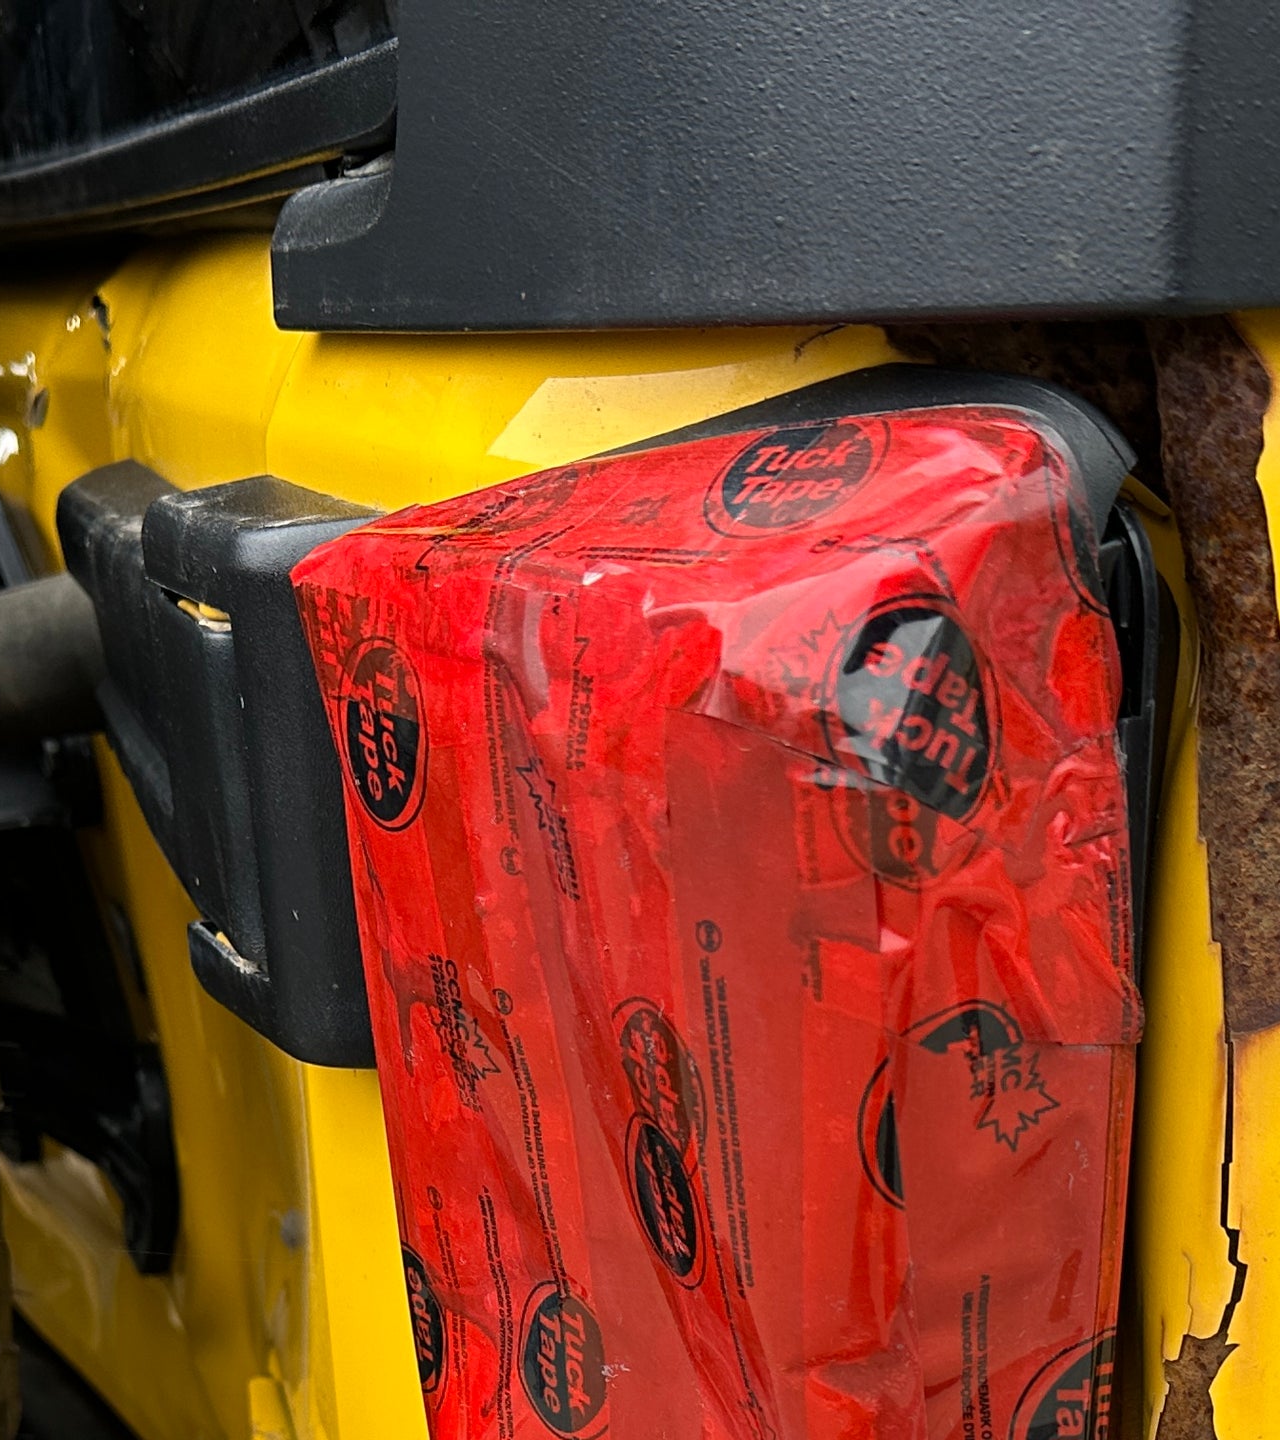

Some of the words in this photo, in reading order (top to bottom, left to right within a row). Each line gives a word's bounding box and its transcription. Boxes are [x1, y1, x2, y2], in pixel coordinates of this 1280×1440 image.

[745, 438, 860, 473] Tuck
[730, 476, 844, 509] Tape
[865, 641, 980, 738] Tape
[354, 680, 383, 802] Tape
[375, 671, 407, 797] Tuck
[865, 698, 977, 796] Tuck
[445, 960, 470, 1041] CCMC
[703, 984, 718, 1046] POLYMER
[717, 1004, 733, 1066] POLYMER
[709, 1047, 727, 1115] INTERTAPE
[715, 1116, 727, 1135] OF
[720, 1139, 734, 1211] TRADEMARK
[738, 1209, 752, 1261] MARQUE
[407, 1266, 434, 1362] Tape
[496, 1260, 513, 1318] TRADEMARK
[536, 1312, 562, 1414] Tape
[561, 1311, 591, 1417] Tuck
[978, 1353, 993, 1428] TRADEMARK
